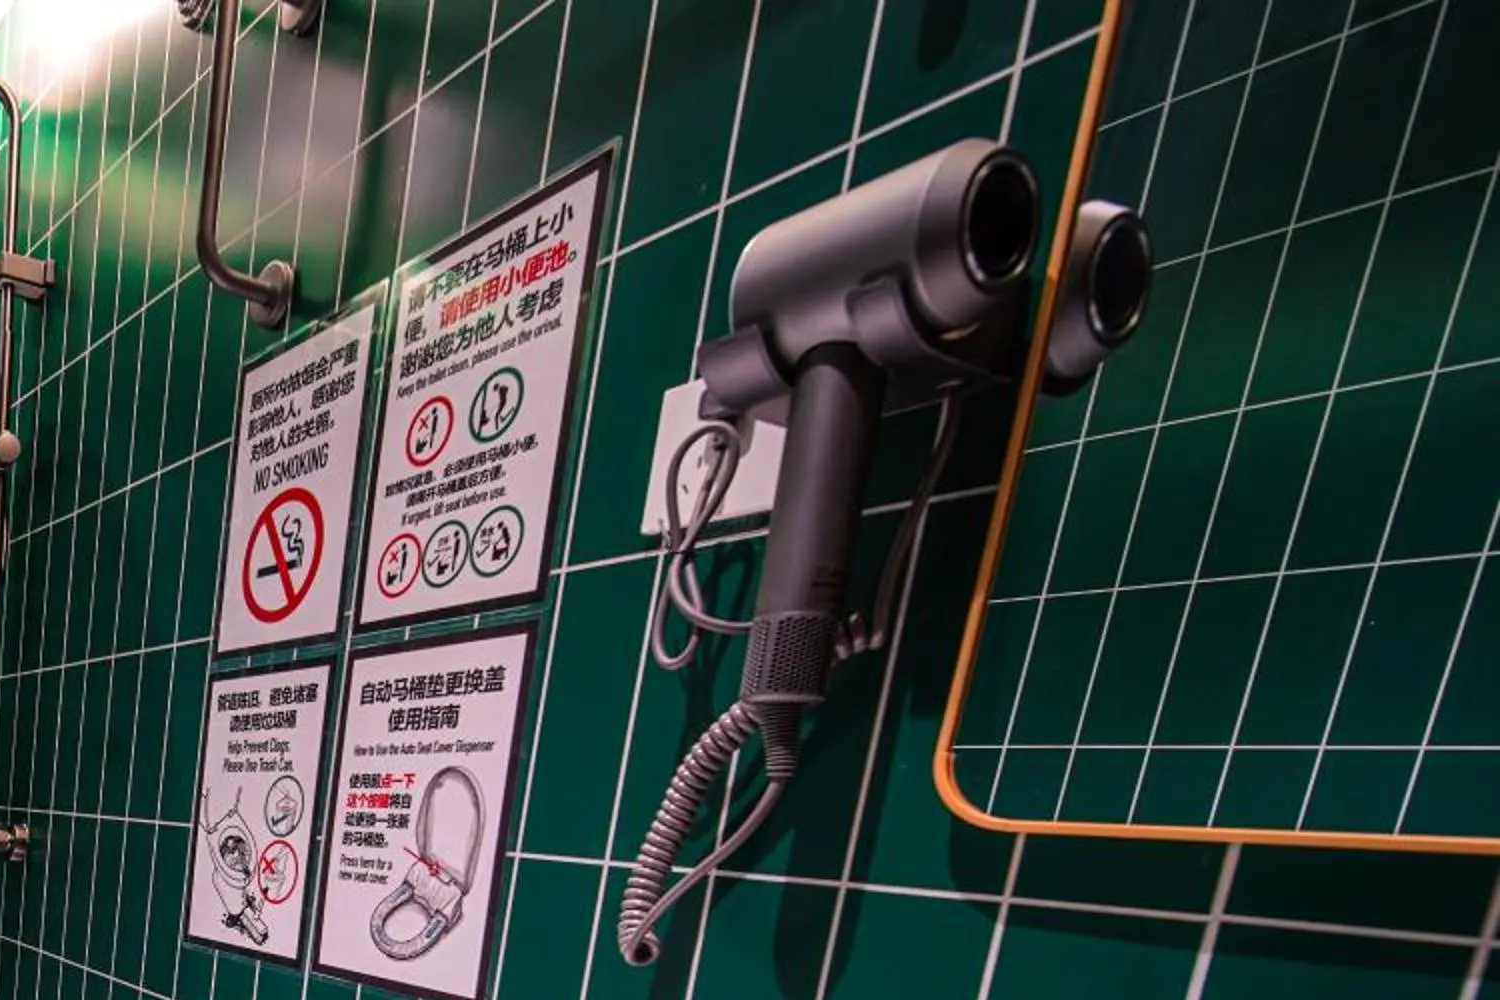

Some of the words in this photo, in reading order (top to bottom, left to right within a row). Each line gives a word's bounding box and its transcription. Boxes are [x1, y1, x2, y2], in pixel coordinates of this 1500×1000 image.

[408, 201, 574, 313] 请不要在马桶上小
[399, 279, 564, 380] 谢谢您为他人考虑
[517, 328, 533, 345] the
[253, 465, 271, 494] NO
[271, 441, 329, 487] SMOKING
[359, 664, 507, 706] 自动马桶垫更换盖
[387, 703, 461, 733] 使用指南
